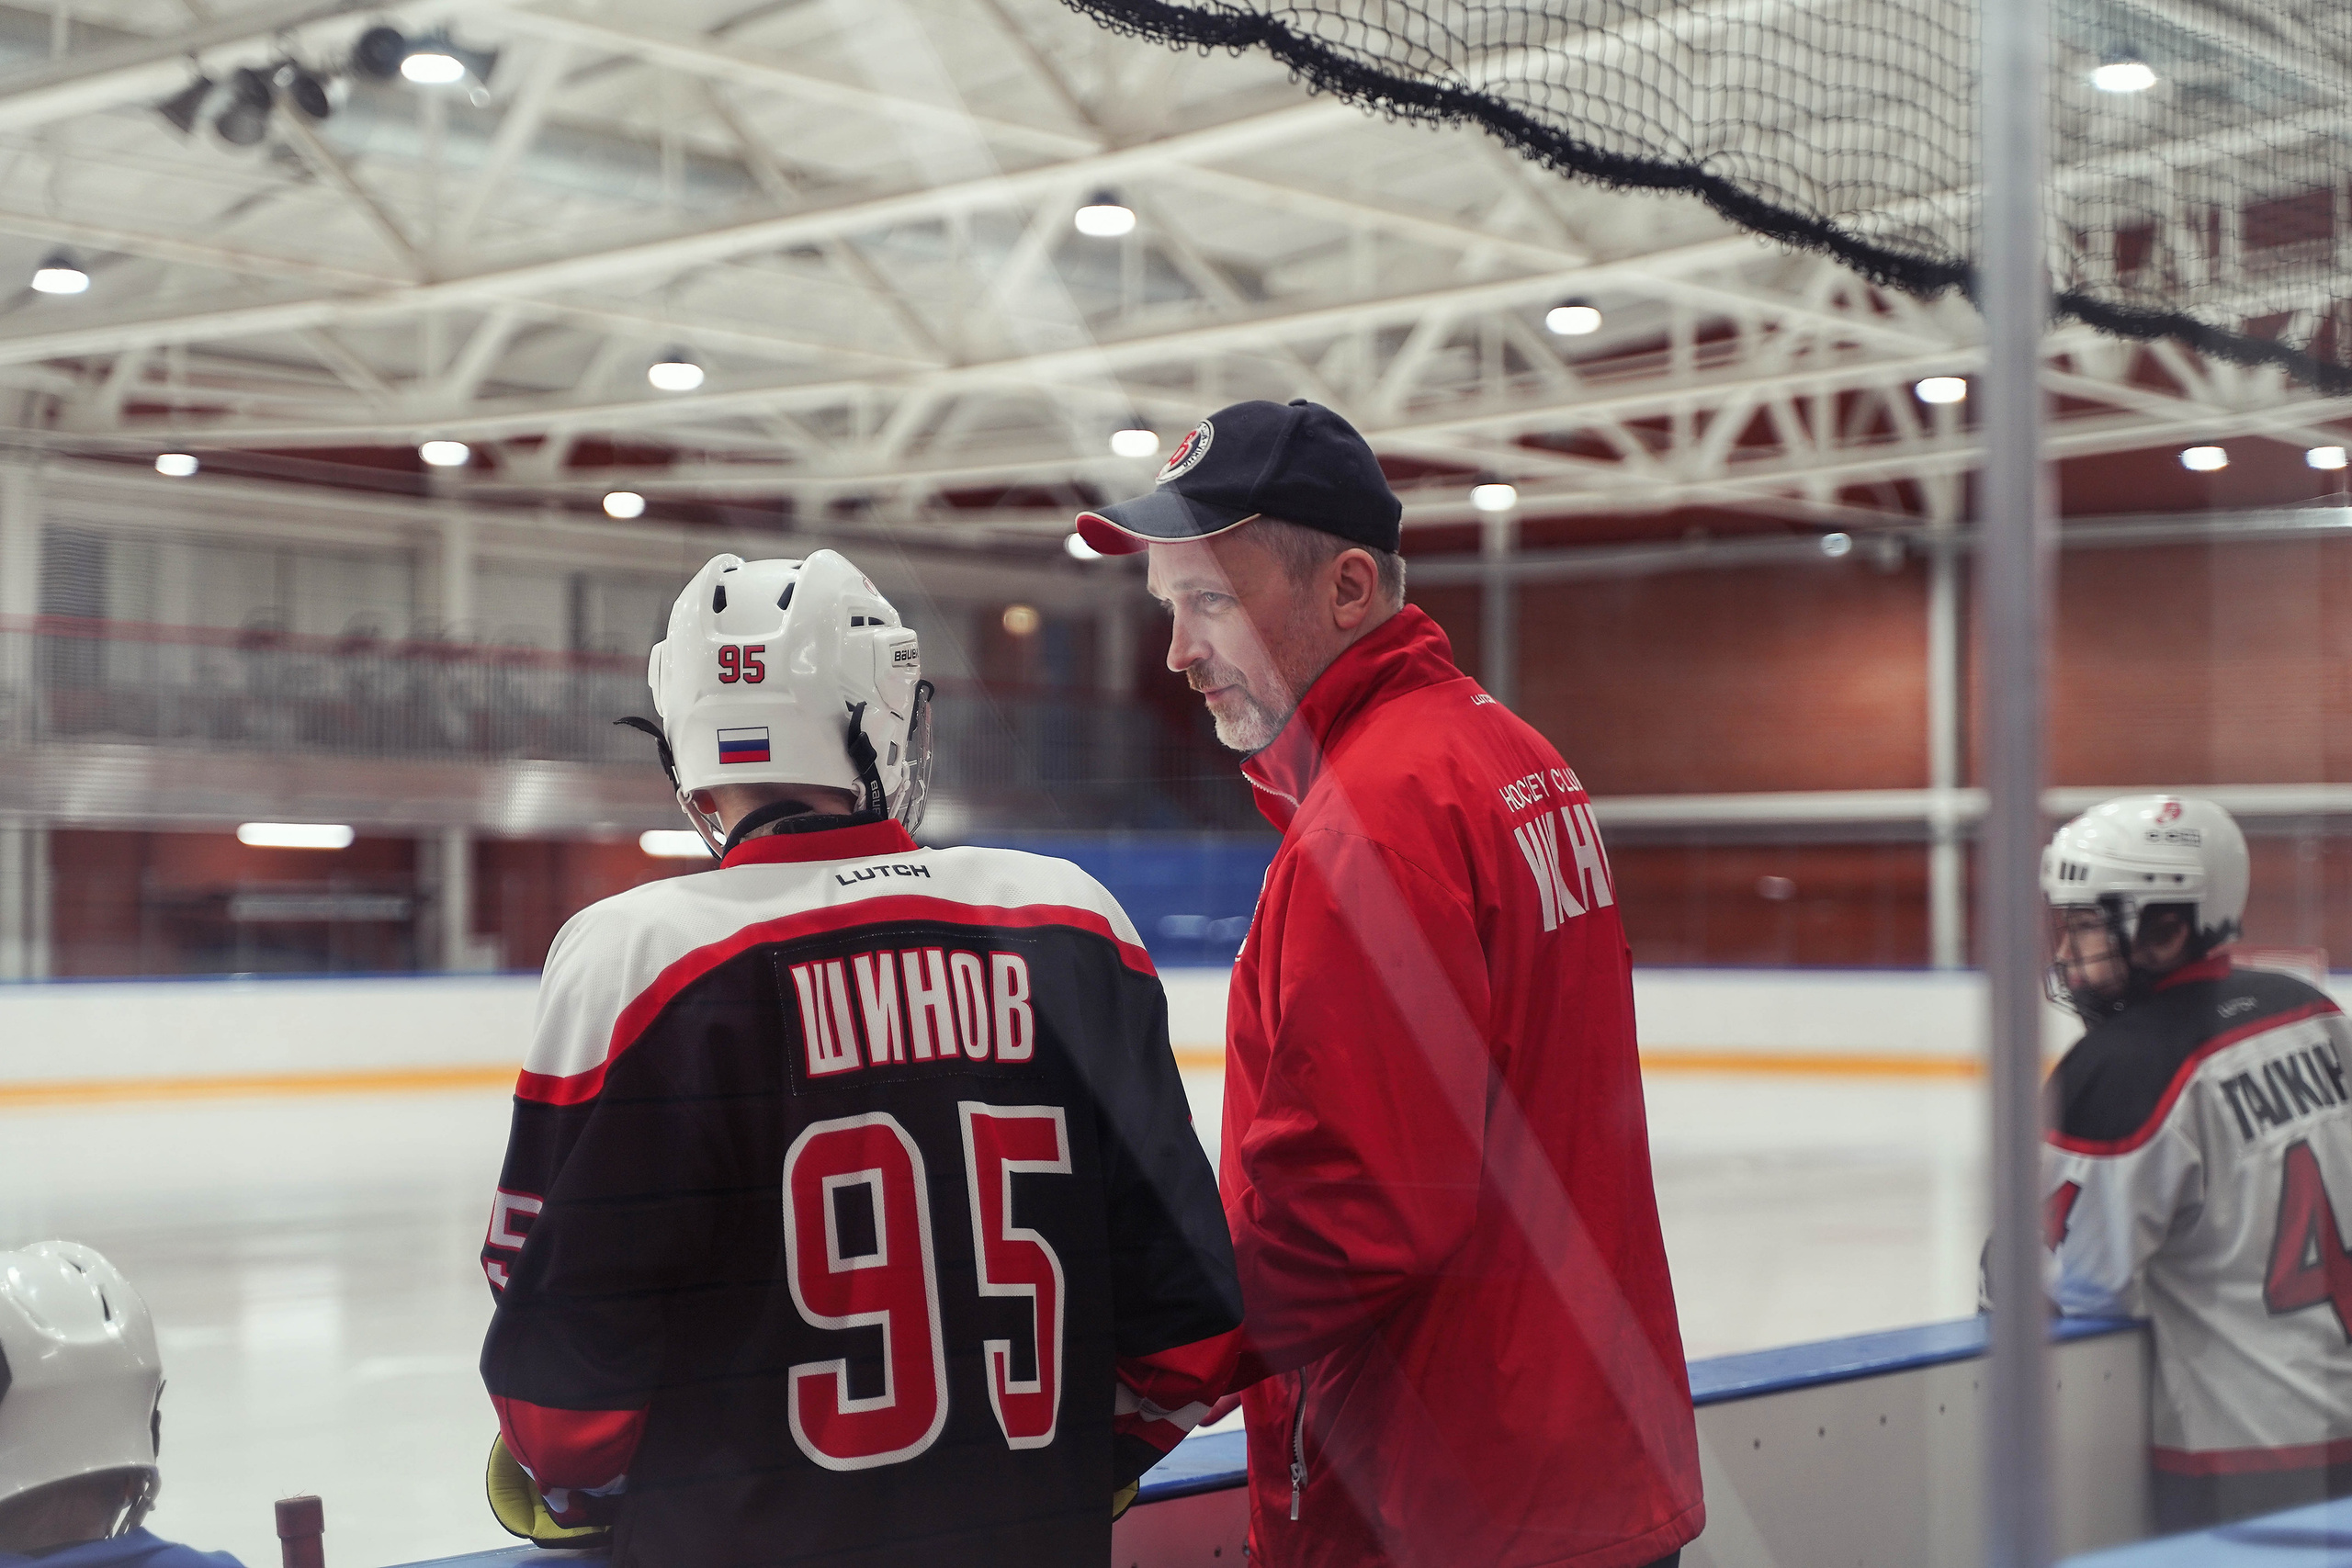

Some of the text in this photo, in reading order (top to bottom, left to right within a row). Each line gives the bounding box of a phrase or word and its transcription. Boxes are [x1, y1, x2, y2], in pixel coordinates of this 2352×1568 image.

[718, 645, 765, 683] 95
[835, 864, 931, 886] LUTCH
[788, 946, 1035, 1078] ШИНОВ
[782, 1100, 1073, 1472] 95
